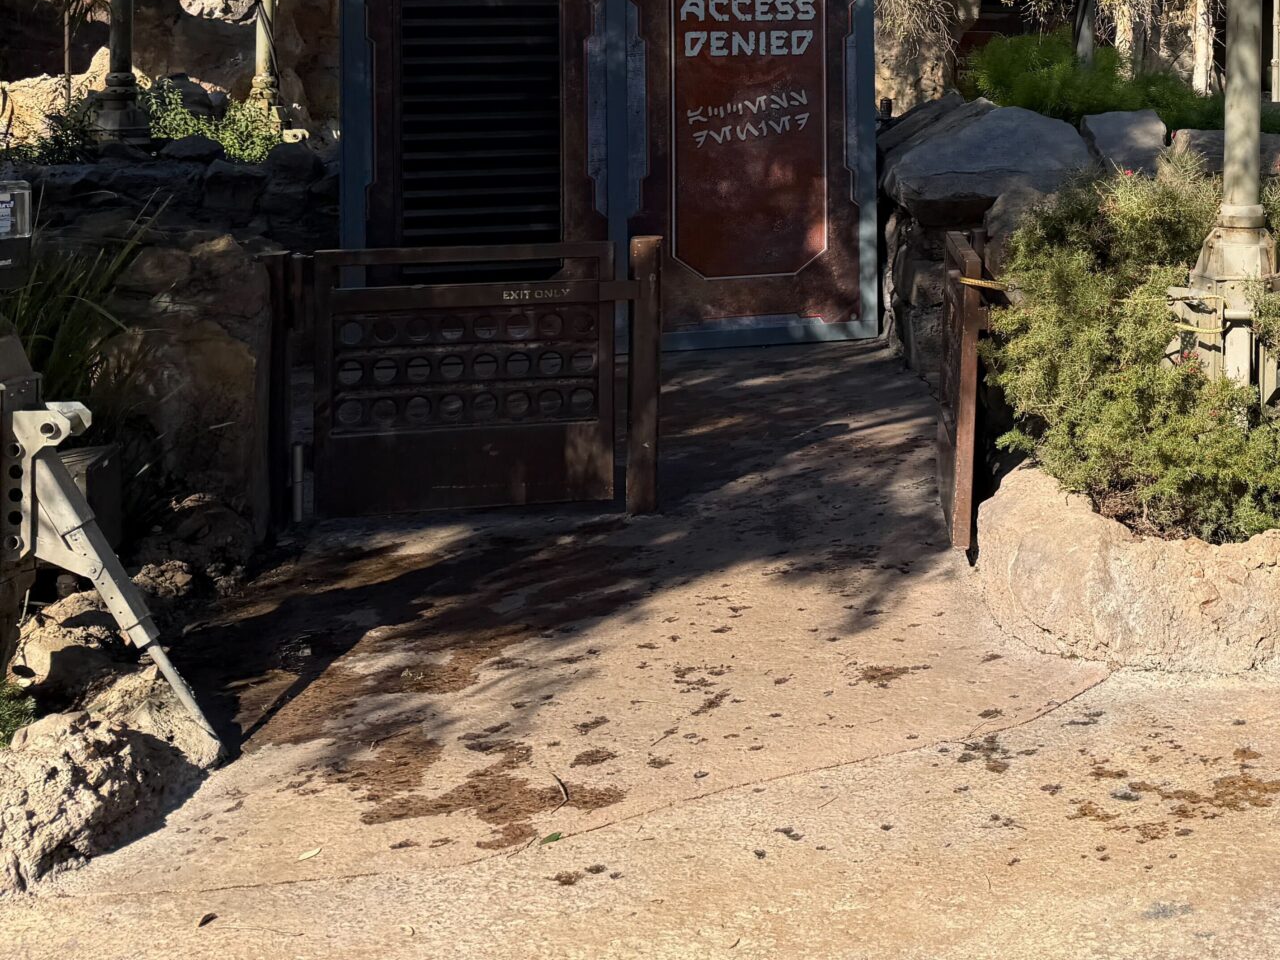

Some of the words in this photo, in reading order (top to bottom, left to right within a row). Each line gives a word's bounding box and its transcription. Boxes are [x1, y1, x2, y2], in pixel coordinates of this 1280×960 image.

[684, 30, 814, 57] DENIED
[503, 290, 531, 300] EXIT
[534, 288, 570, 299] ONLY
